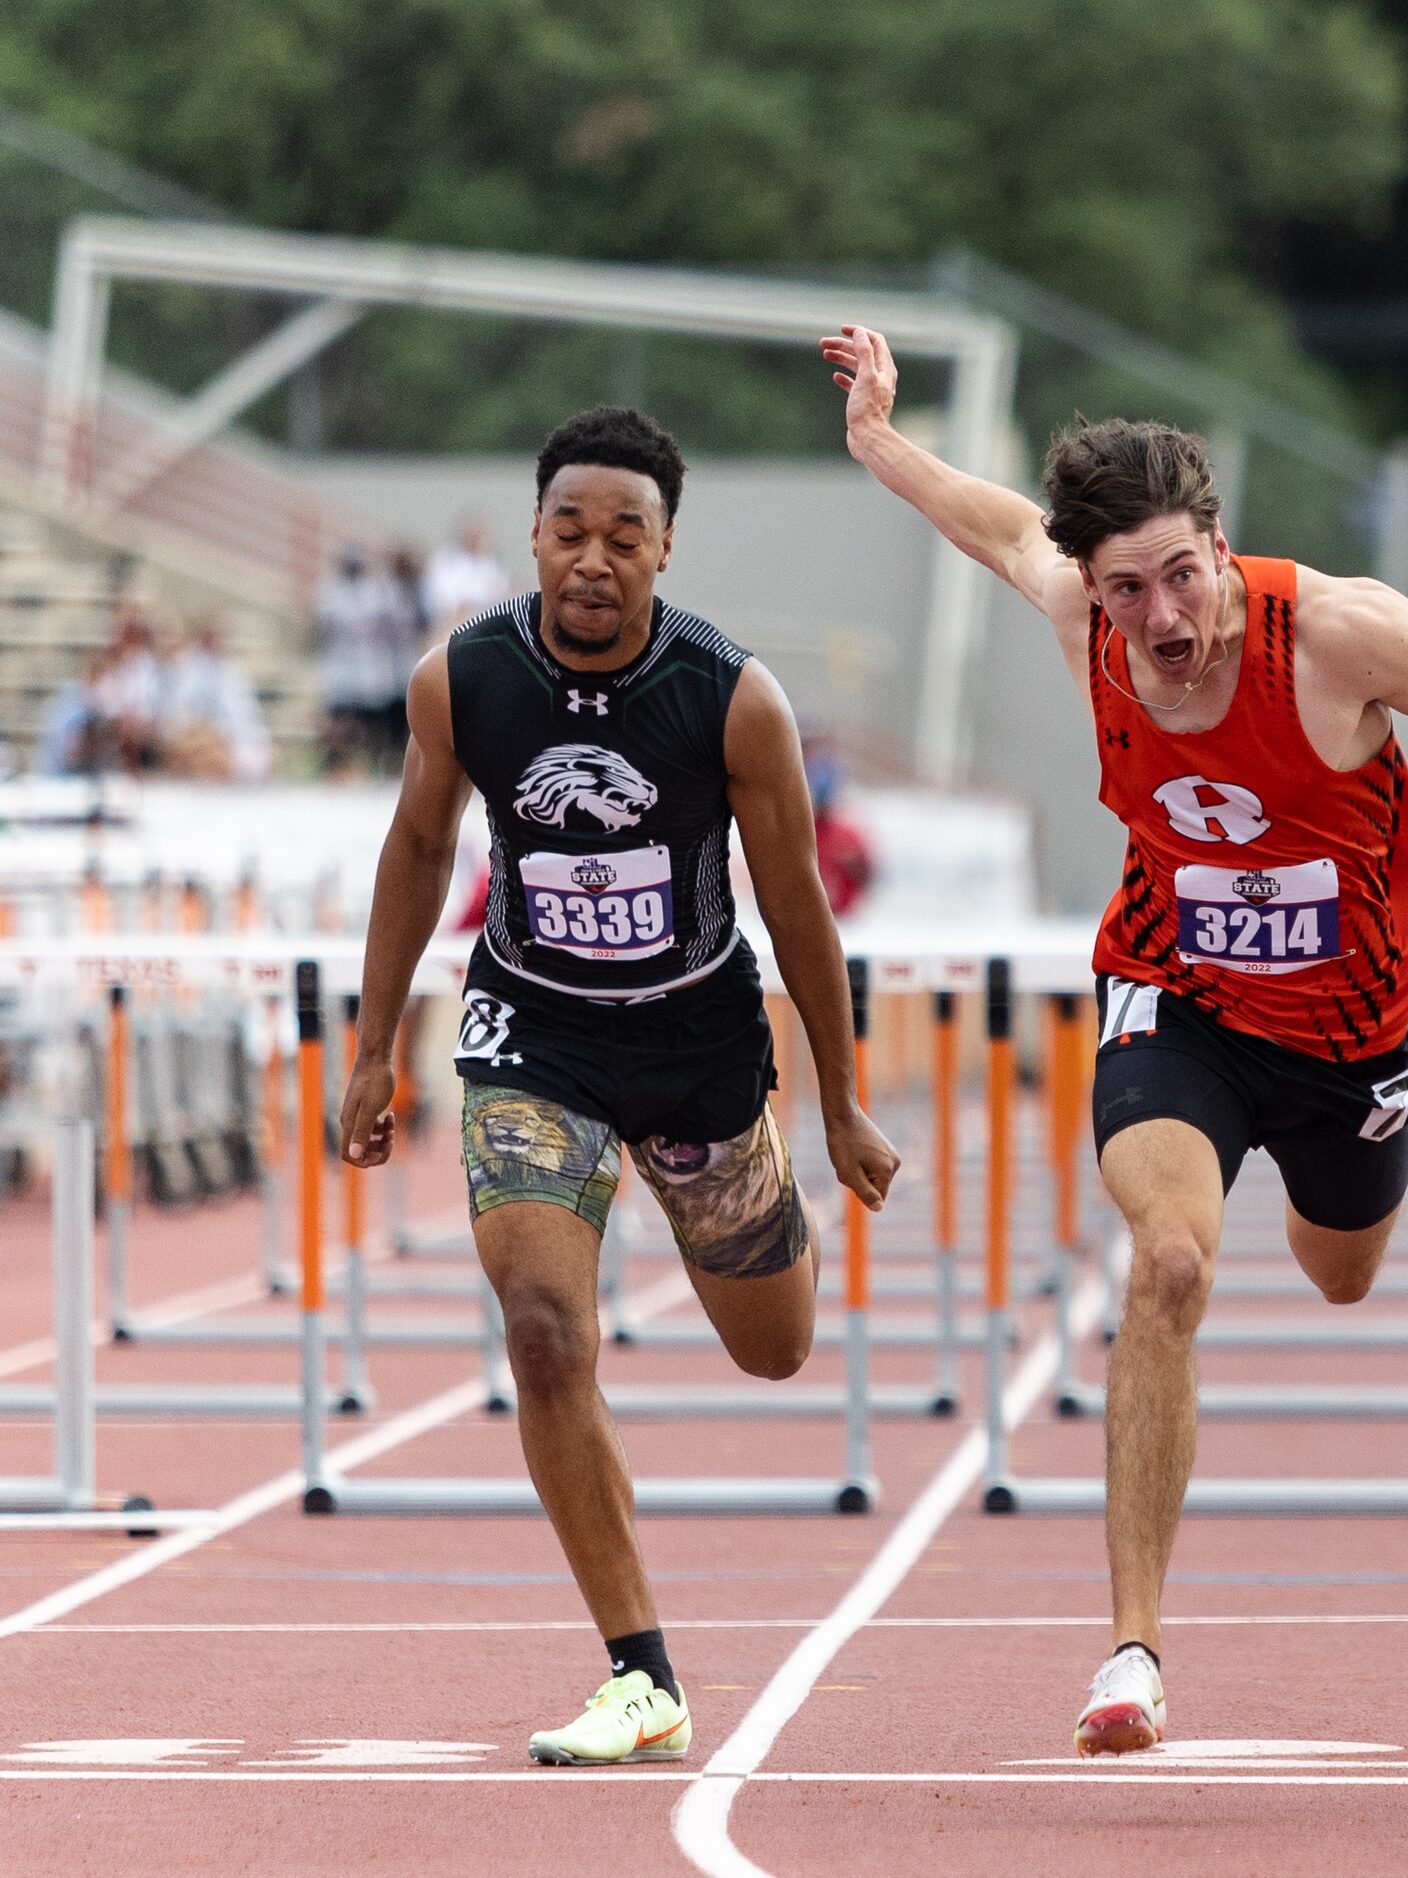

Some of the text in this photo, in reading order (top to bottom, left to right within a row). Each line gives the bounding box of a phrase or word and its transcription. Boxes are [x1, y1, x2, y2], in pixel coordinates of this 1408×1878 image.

[571, 871, 617, 882] STATE
[1233, 882, 1281, 895] STATE
[535, 892, 665, 944] 3339
[1196, 907, 1321, 956] 3214
[591, 950, 616, 958] 2022
[1245, 963, 1271, 972] 2022
